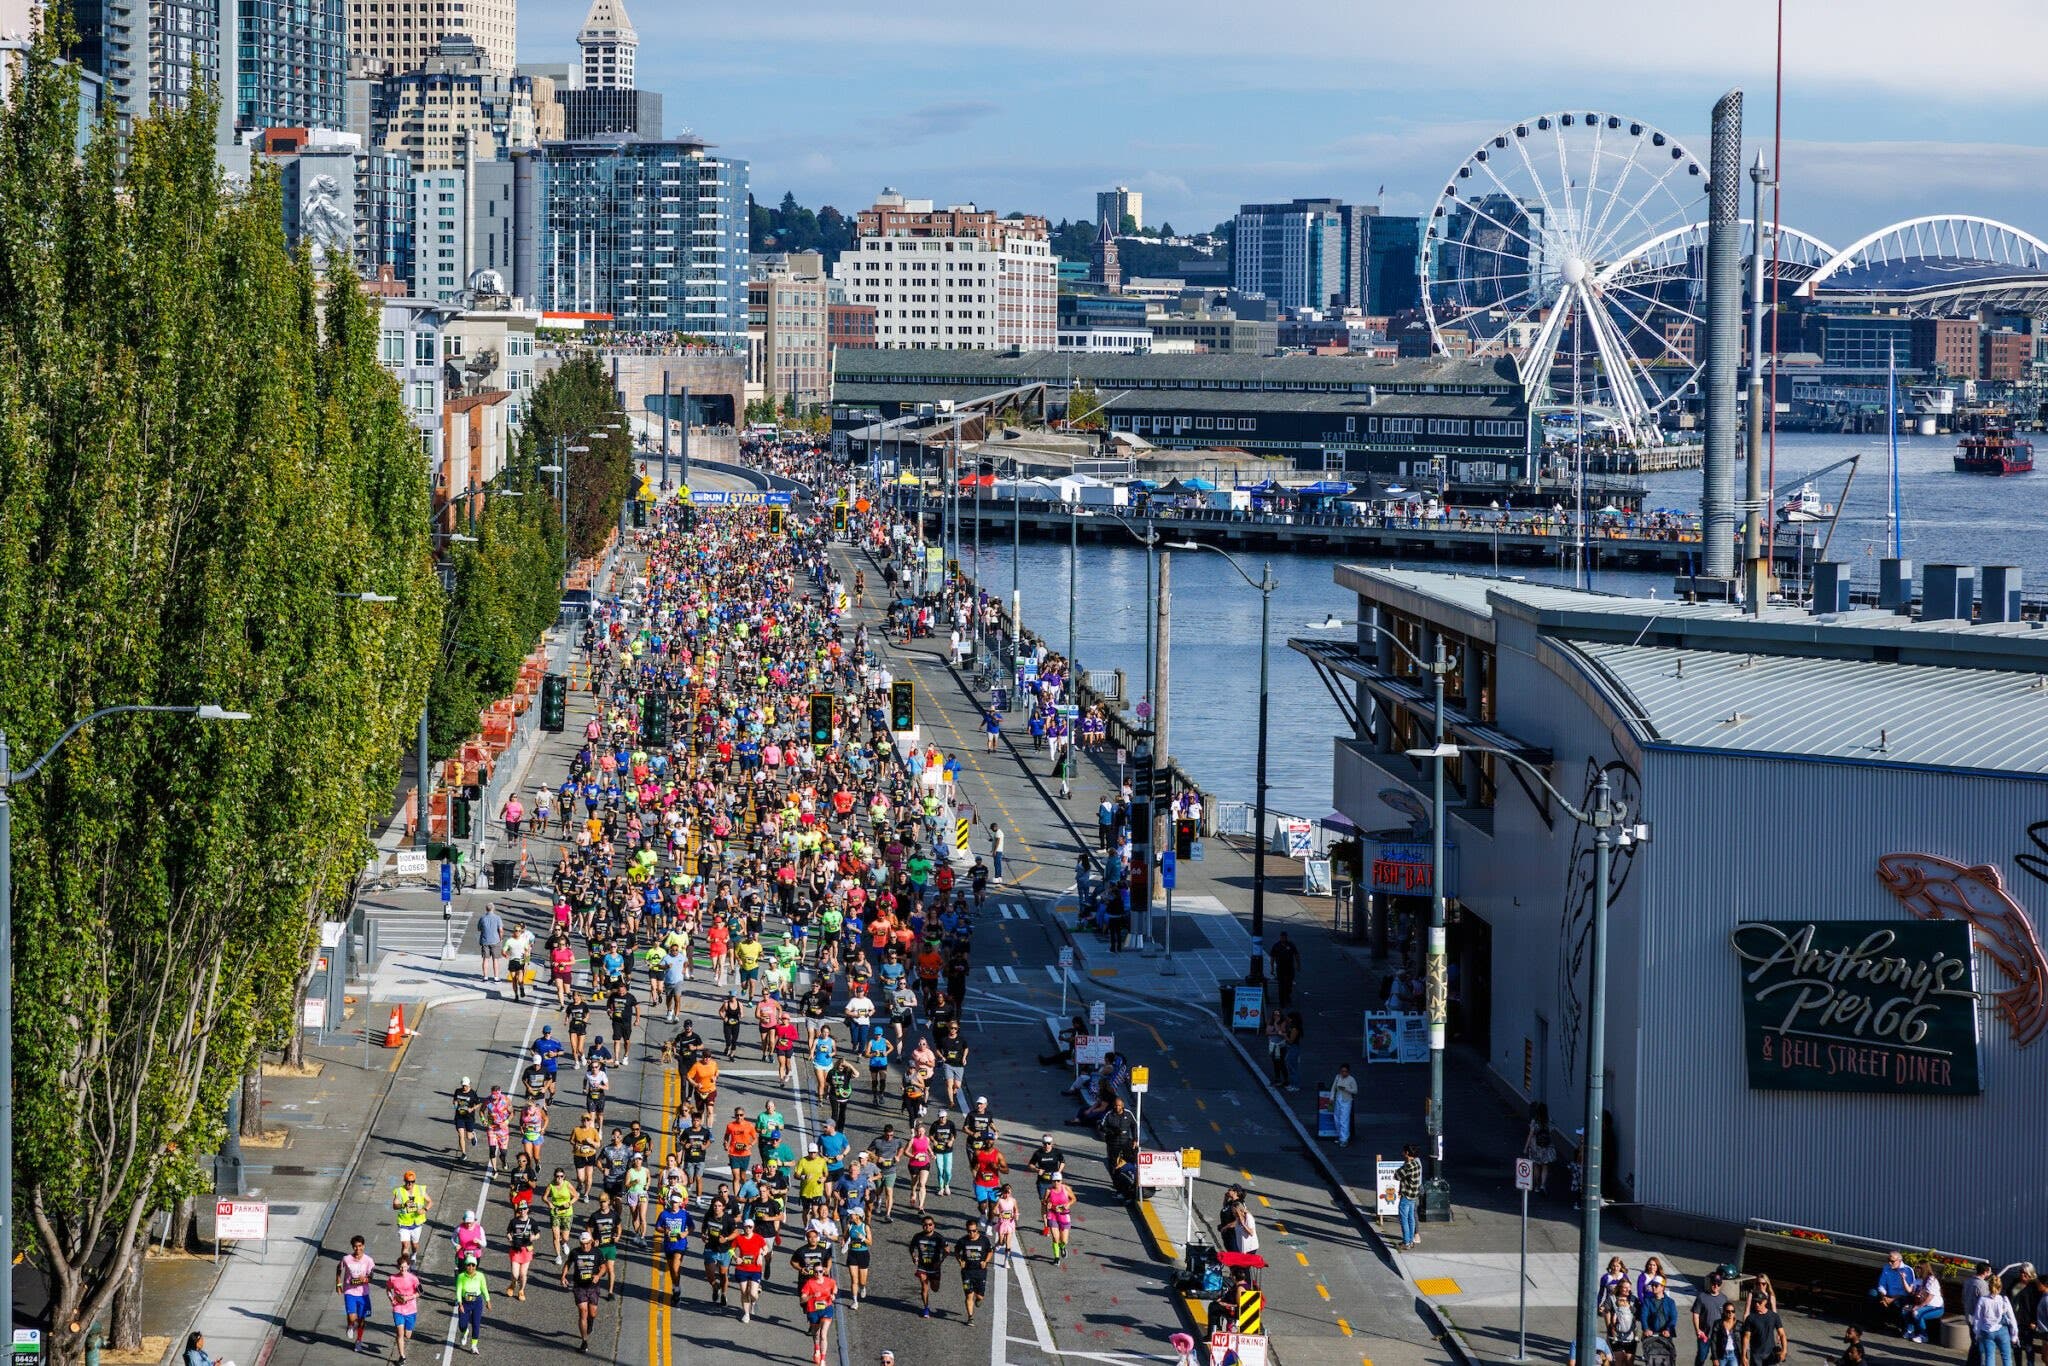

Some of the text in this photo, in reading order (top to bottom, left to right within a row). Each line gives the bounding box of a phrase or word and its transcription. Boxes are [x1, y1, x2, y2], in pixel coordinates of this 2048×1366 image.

[1321, 432, 1415, 444] SEATTLE AQUARIUM
[703, 493, 723, 502] RUN
[730, 493, 767, 503] START
[400, 864, 425, 872] CLOSED
[1730, 923, 1983, 1004] Anthony's
[1755, 979, 1942, 1044] Pier 66
[1076, 1036, 1087, 1045] NO
[1763, 1035, 1952, 1087] & BELL STREET DINER
[1140, 1154, 1152, 1163] NO
[219, 1204, 265, 1214] NO PARKING
[1214, 1335, 1228, 1346] NO
